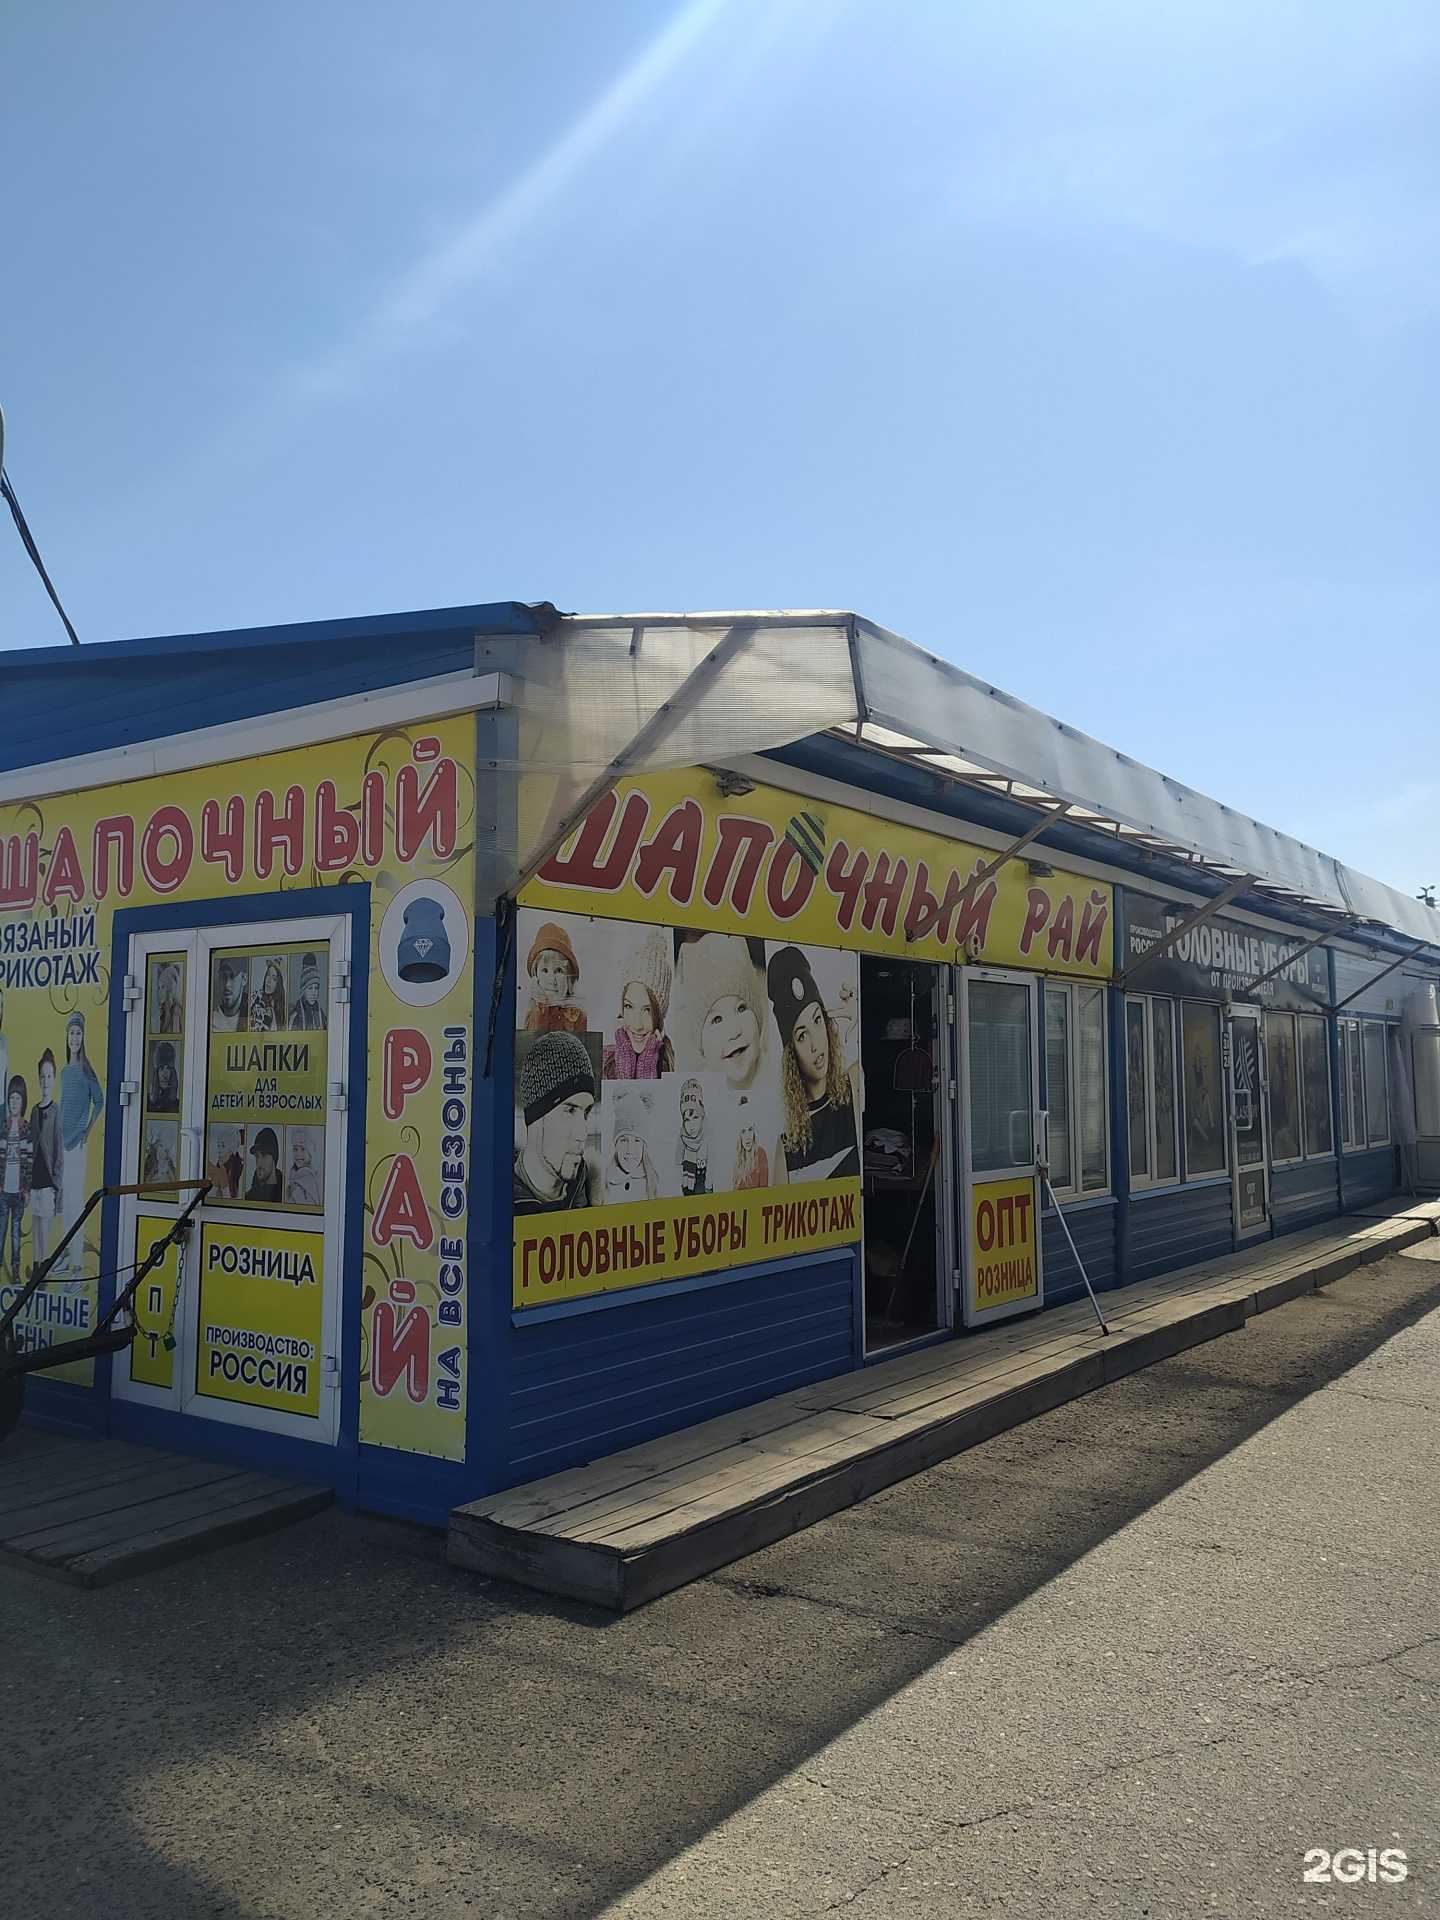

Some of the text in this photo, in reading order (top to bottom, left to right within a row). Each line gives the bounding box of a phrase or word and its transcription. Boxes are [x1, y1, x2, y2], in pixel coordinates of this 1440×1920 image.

[535, 786, 1110, 966] ШАПОЧНЫЙ РАЙ
[0, 908, 95, 953] ЯЗАНЫЙ
[1210, 970, 1220, 988] ОТ
[226, 1044, 309, 1071] ШАПКИ
[211, 1091, 322, 1109] ДЕТЕЙ И ВЗРОСЛЫХ
[254, 1078, 277, 1094] ДЛЯ
[371, 1026, 434, 1403] РАЙ
[436, 1026, 468, 1410] НА ВСЕ СЕЗОНЫ
[977, 1193, 1031, 1251] ОПТ
[522, 1192, 857, 1288] ГОЛОВНЫЕ УБОРЫ ТРИКОТАЖ
[209, 1244, 315, 1286] РОЗНИЦА
[977, 1257, 1033, 1299] РОЗНИЦА
[206, 1326, 314, 1359] ПРОИЗВОДСТВО:
[210, 1350, 307, 1394] РОССИЯ
